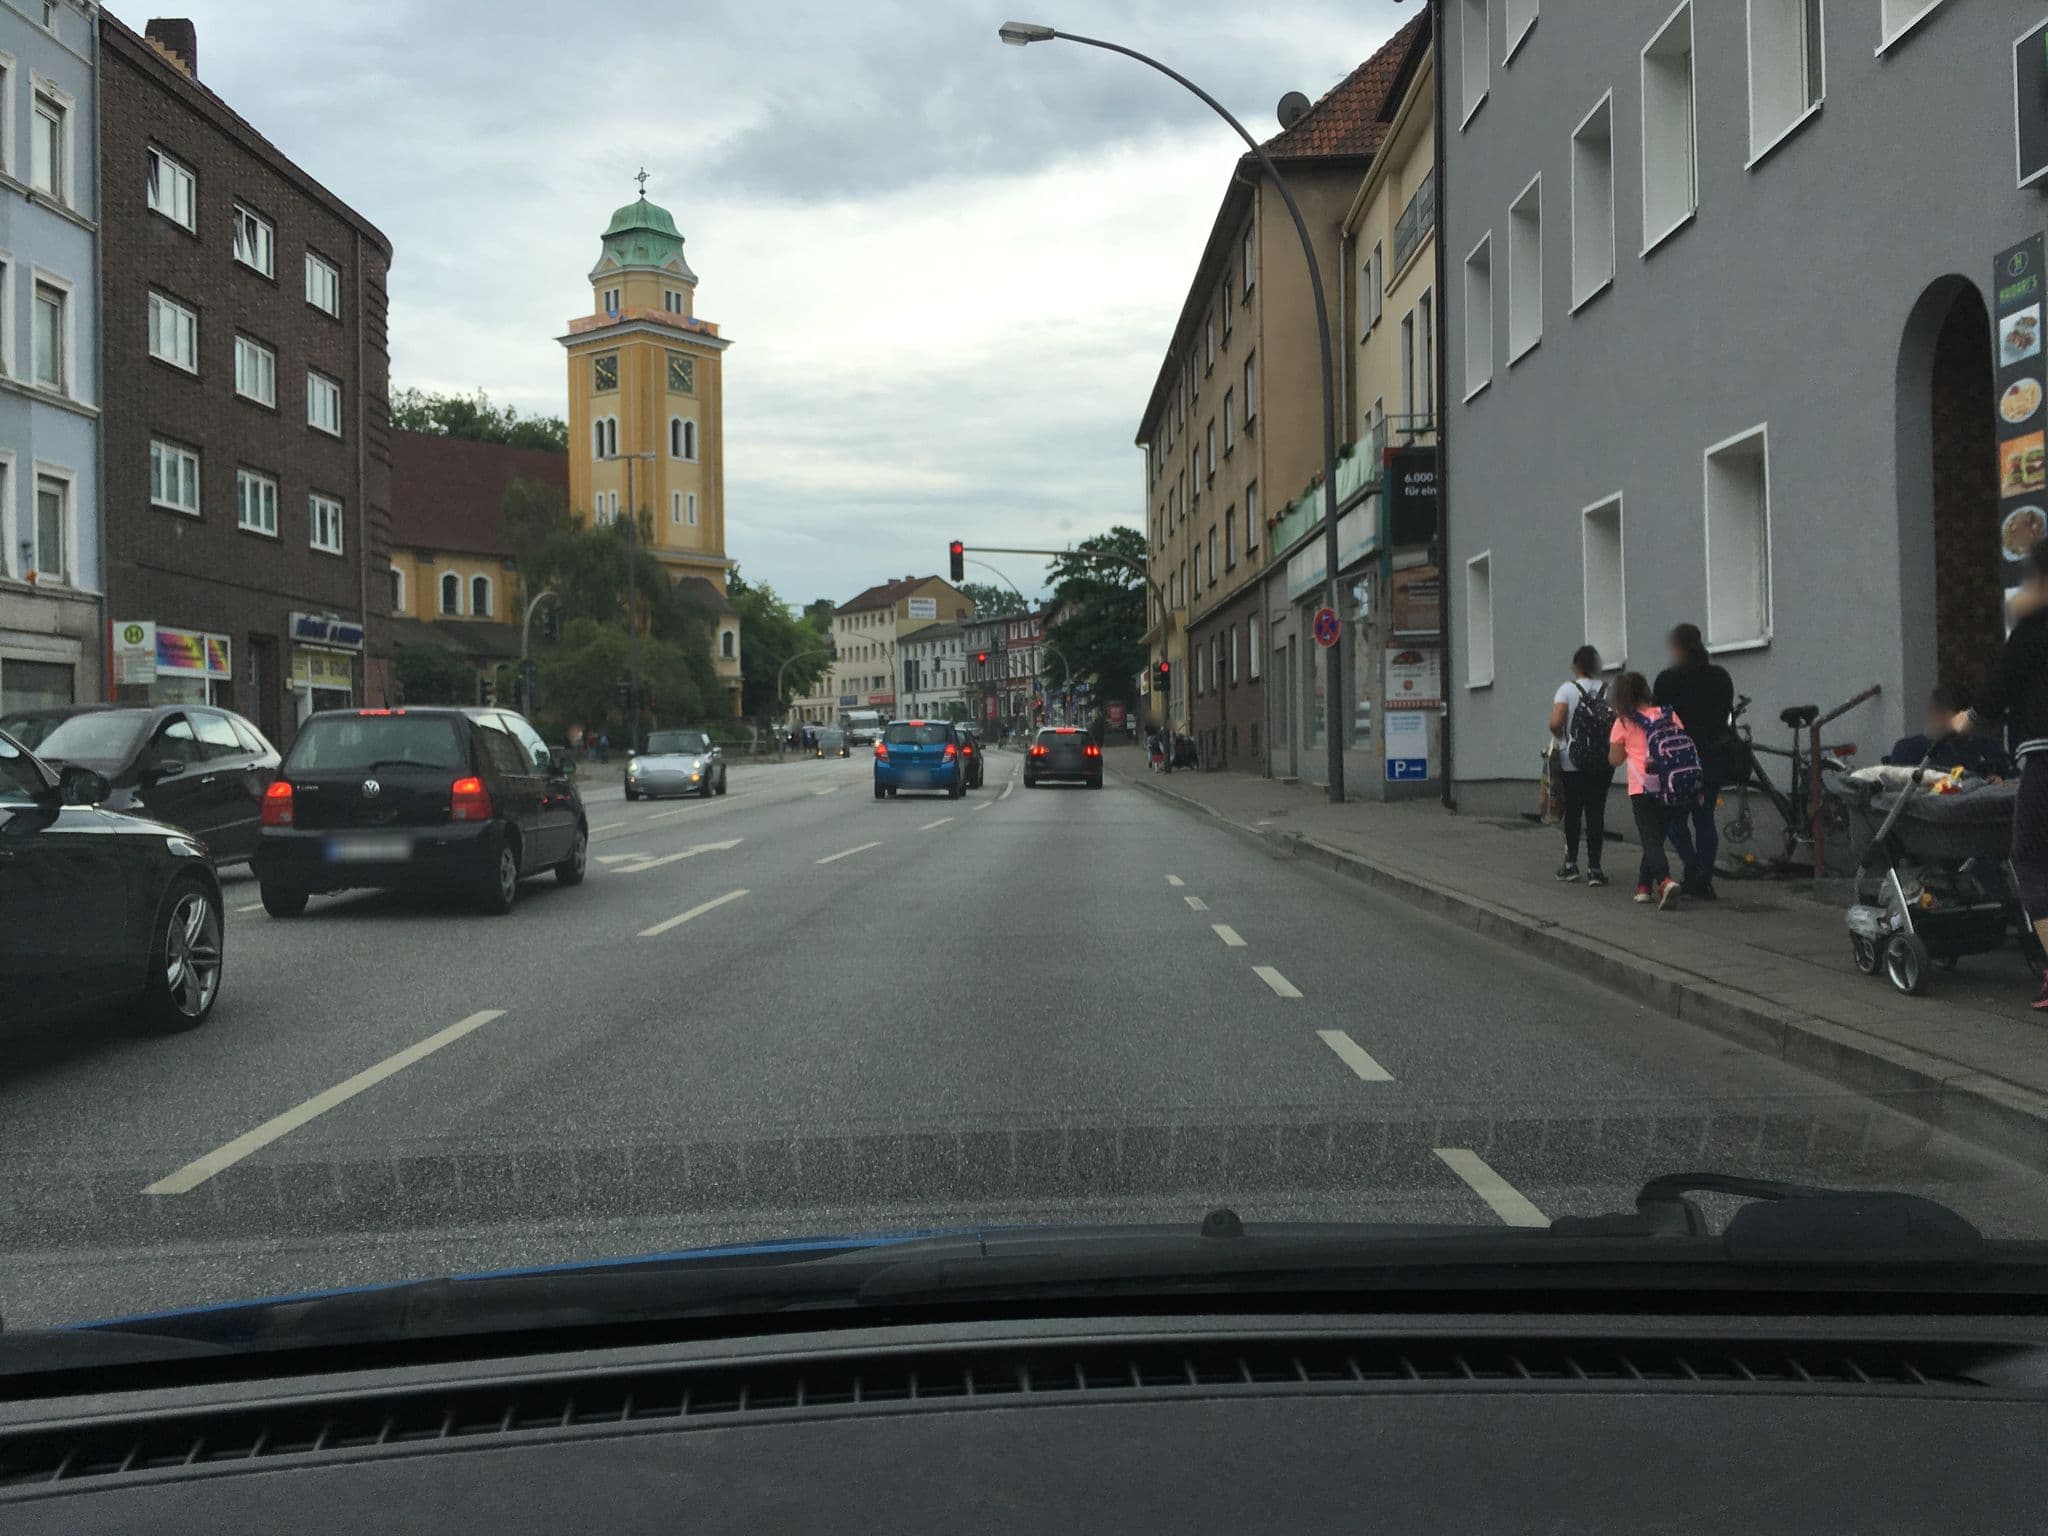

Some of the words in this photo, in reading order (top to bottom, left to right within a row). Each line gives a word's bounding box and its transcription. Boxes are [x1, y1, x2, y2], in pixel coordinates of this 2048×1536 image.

[1404, 471, 1434, 483] 6.000
[1405, 486, 1420, 497] für
[1395, 760, 1406, 778] P
